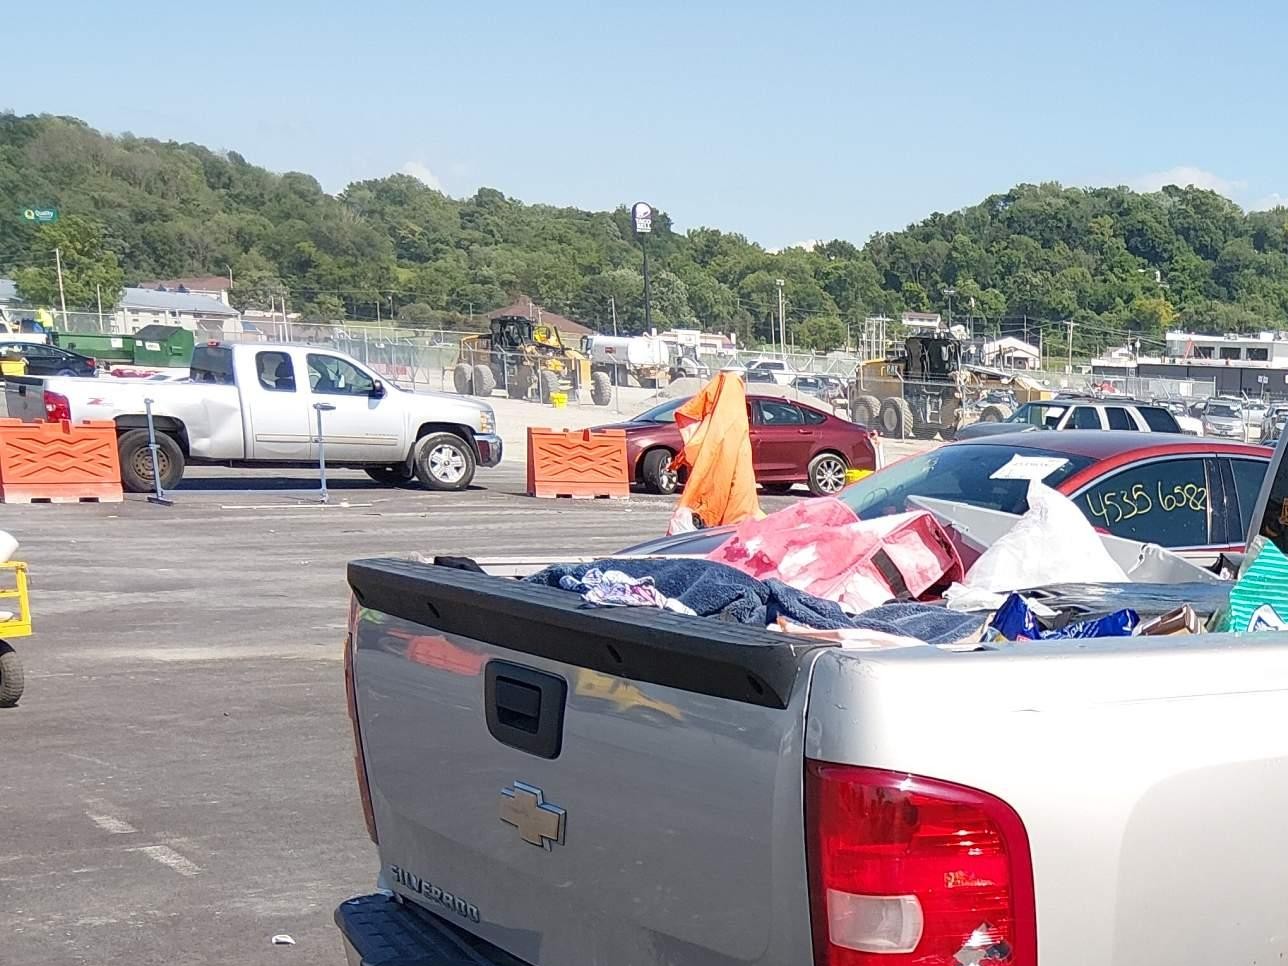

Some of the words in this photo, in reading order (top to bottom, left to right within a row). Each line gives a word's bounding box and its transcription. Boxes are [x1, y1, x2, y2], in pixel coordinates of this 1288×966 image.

[1085, 483, 1154, 527] 4535
[1157, 480, 1207, 512] 6582
[389, 863, 481, 924] SILVERADO
